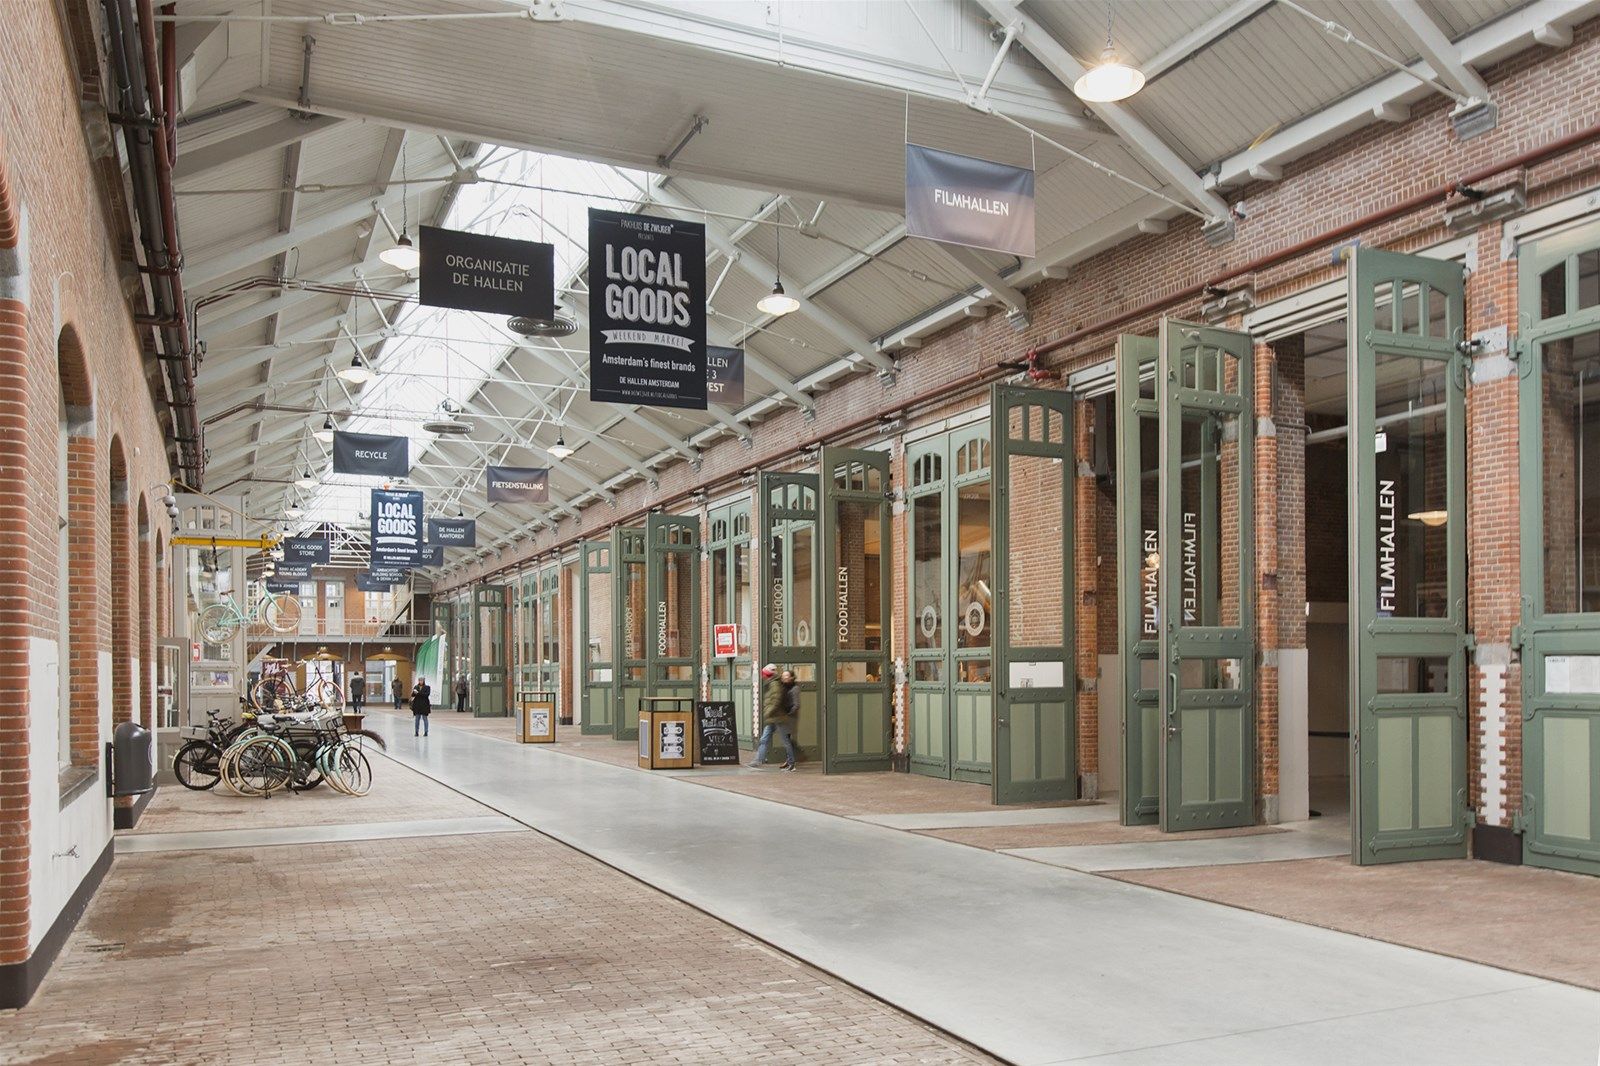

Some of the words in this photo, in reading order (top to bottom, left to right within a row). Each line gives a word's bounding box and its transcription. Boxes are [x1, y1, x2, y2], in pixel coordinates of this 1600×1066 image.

[934, 188, 1009, 216] FILMHALLEN
[643, 222, 650, 231] DE
[445, 254, 530, 276] ORGANISATIE
[606, 244, 690, 288] LOCAL
[453, 272, 470, 286] DE
[474, 275, 523, 292] HALLEN
[605, 283, 691, 327] GOODS
[612, 331, 647, 341] WEEKEND
[654, 333, 685, 347] MARKET
[602, 353, 649, 368] Amsterdam's
[650, 358, 670, 370] finest
[671, 360, 696, 373] brands
[707, 356, 729, 368] LLEN
[620, 376, 627, 384] DE
[627, 377, 648, 386] HALLEN
[648, 379, 680, 388] AMSTERDAM
[355, 450, 388, 460] RECYCLE
[492, 481, 544, 491] FIETSENSTALLING
[377, 502, 416, 519] LOCAL
[377, 518, 417, 535] GOODS
[1380, 480, 1396, 611] FILMHALLEN
[838, 566, 849, 642] FOODHALLEN
[658, 601, 667, 655] FOODHALLEN
